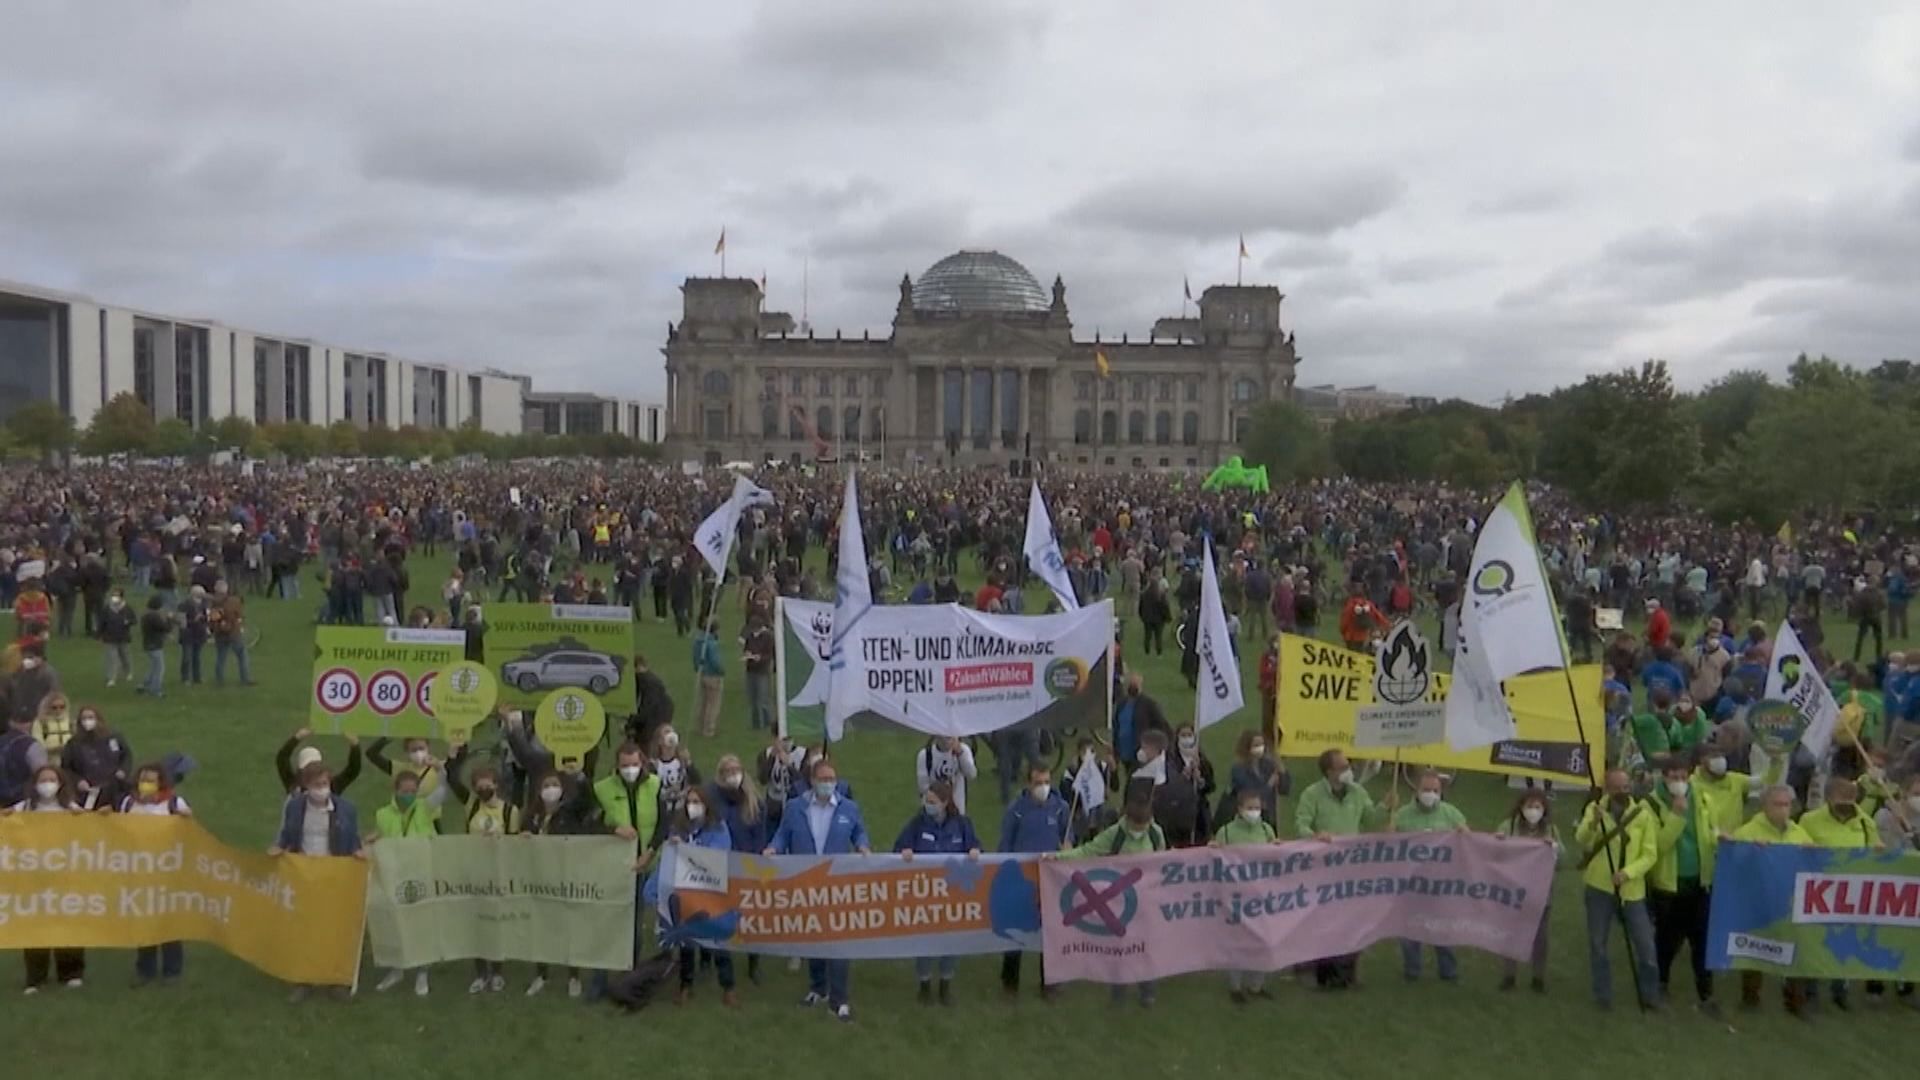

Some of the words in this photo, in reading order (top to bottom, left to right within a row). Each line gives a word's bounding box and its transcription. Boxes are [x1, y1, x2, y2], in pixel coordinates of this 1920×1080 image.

[333, 647, 408, 661] TEMPOLIMIT
[413, 649, 450, 663] JETZT!
[915, 637, 950, 661] UND
[1202, 626, 1229, 699] GEND
[328, 682, 352, 699] 30
[377, 684, 401, 701] 80
[867, 668, 933, 693] OPPEN!
[1300, 674, 1361, 701] SAVE
[1161, 852, 1313, 885] Zukunft
[1323, 839, 1453, 866] wählen
[434, 879, 508, 897] Deutsche
[509, 879, 604, 900] Umwelthilfe
[689, 873, 720, 885] NABU
[739, 881, 888, 909] ZUSAMMEN
[896, 873, 949, 899] FÜR
[119, 885, 232, 923] Klima!
[1160, 892, 1221, 921] wir
[1225, 884, 1310, 925] jetzt
[1803, 880, 1920, 917] KLIM
[739, 913, 823, 935] KLIMA
[829, 908, 886, 931] UND
[893, 902, 983, 927] NATUR
[1062, 941, 1145, 957] #klimawahl
